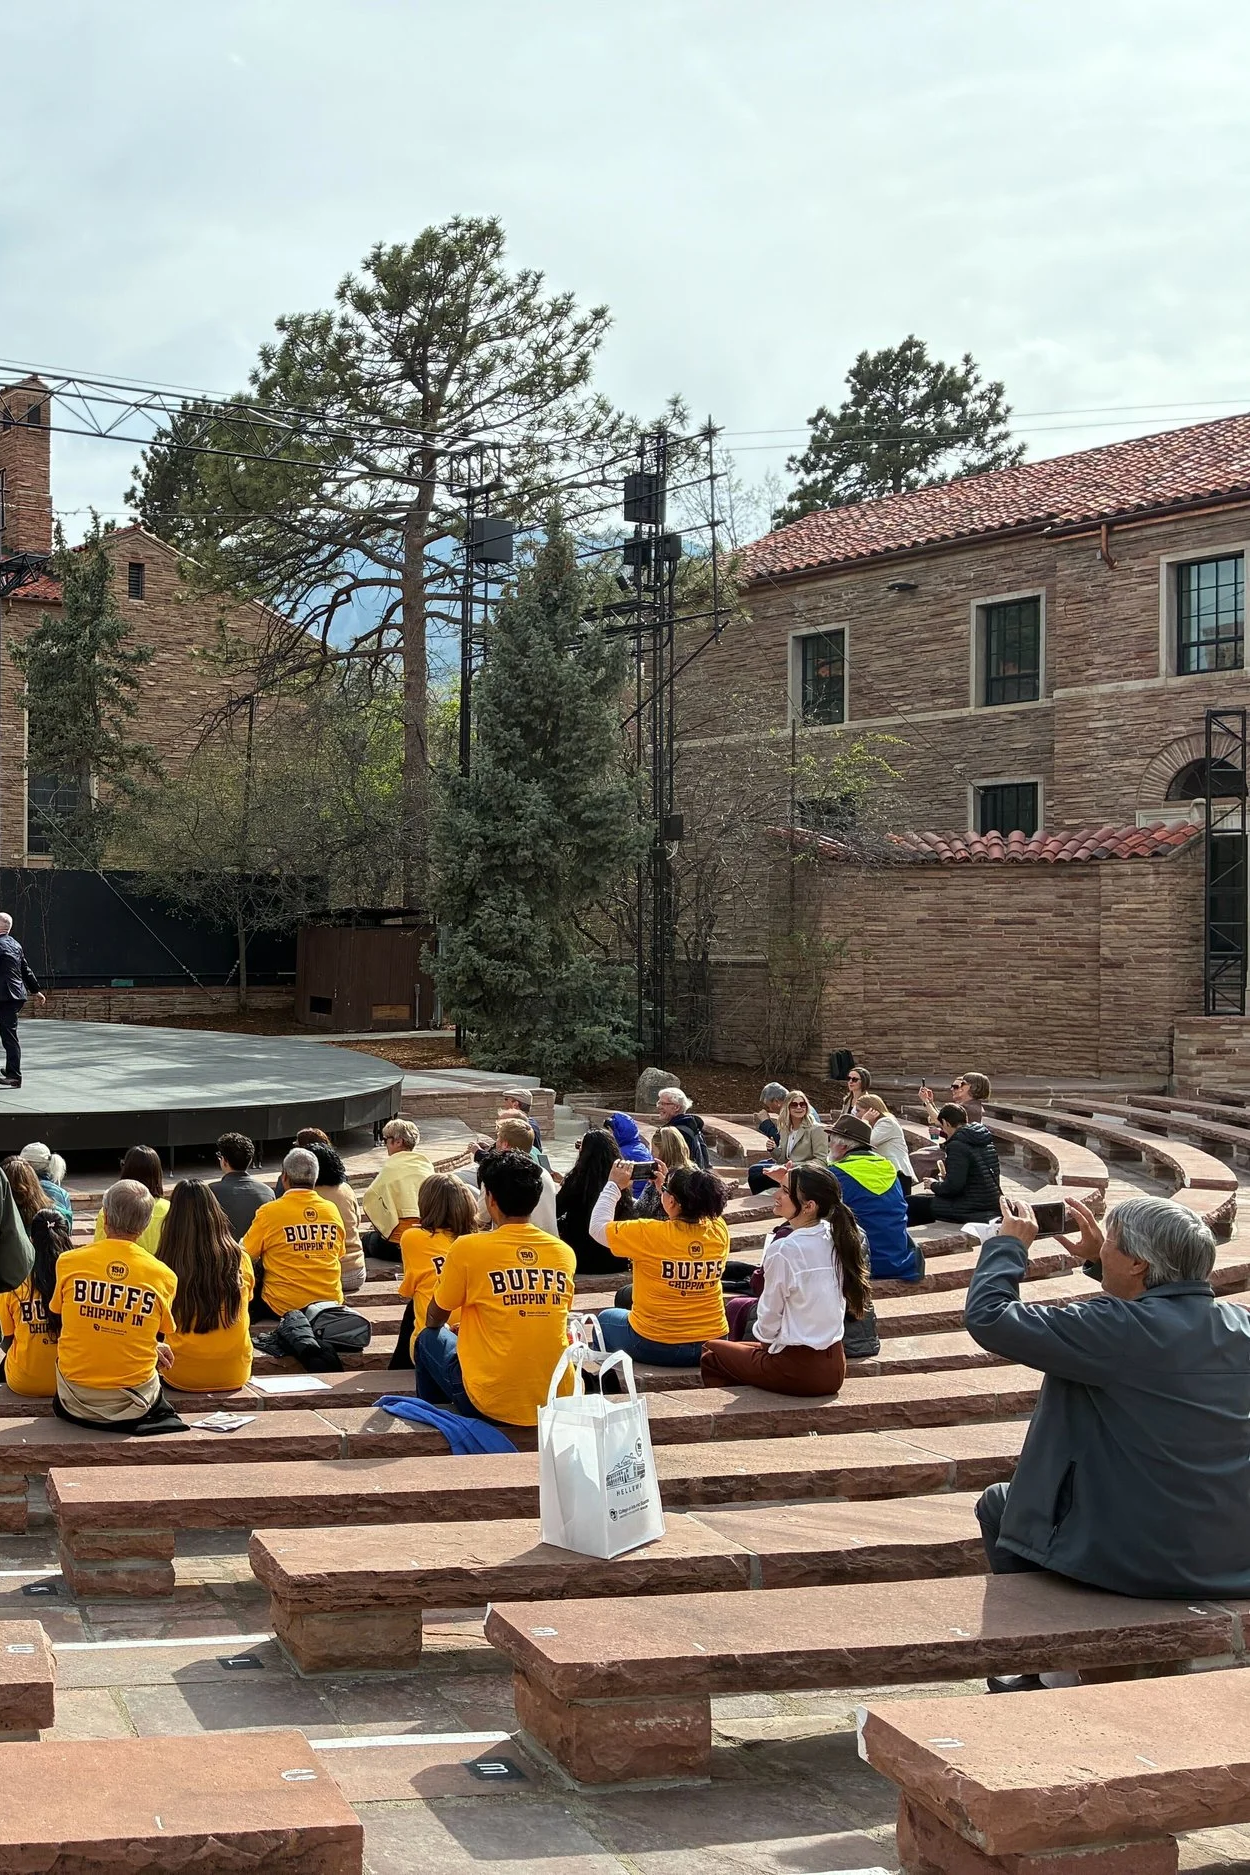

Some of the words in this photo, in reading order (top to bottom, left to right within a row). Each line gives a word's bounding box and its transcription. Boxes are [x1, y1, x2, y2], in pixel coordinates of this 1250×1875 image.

[283, 1223, 337, 1244] BUFFS
[520, 1250, 534, 1260] 150
[111, 1265, 125, 1275] 150
[661, 1259, 723, 1281] BUFFS
[488, 1268, 568, 1295] BUFFS
[73, 1278, 156, 1316] BUFFS
[502, 1293, 548, 1306] CHIPPIN'
[552, 1293, 561, 1306] IN
[79, 1304, 128, 1324] CHIPPIN'
[131, 1313, 145, 1327] IN
